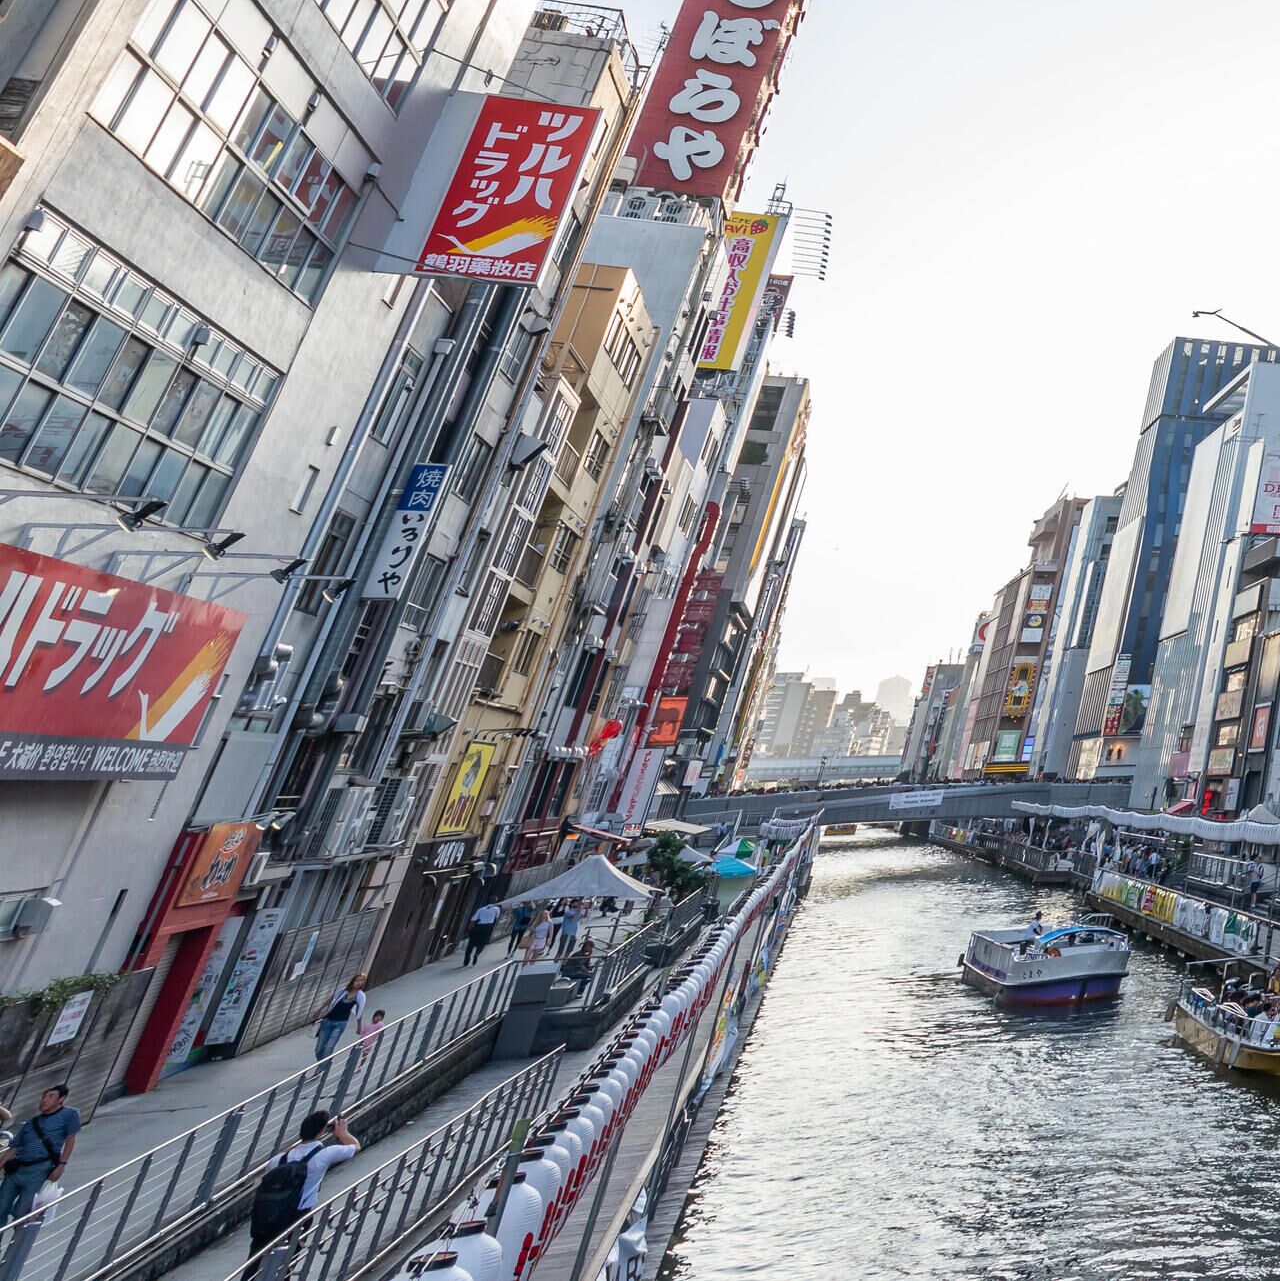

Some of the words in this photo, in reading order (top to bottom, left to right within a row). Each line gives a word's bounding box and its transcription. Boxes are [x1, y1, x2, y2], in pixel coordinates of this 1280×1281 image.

[452, 122, 529, 227] ドラッグ
[503, 111, 584, 209] ツルハ
[408, 469, 443, 509] 焼肉
[90, 746, 153, 773] WELCOME
